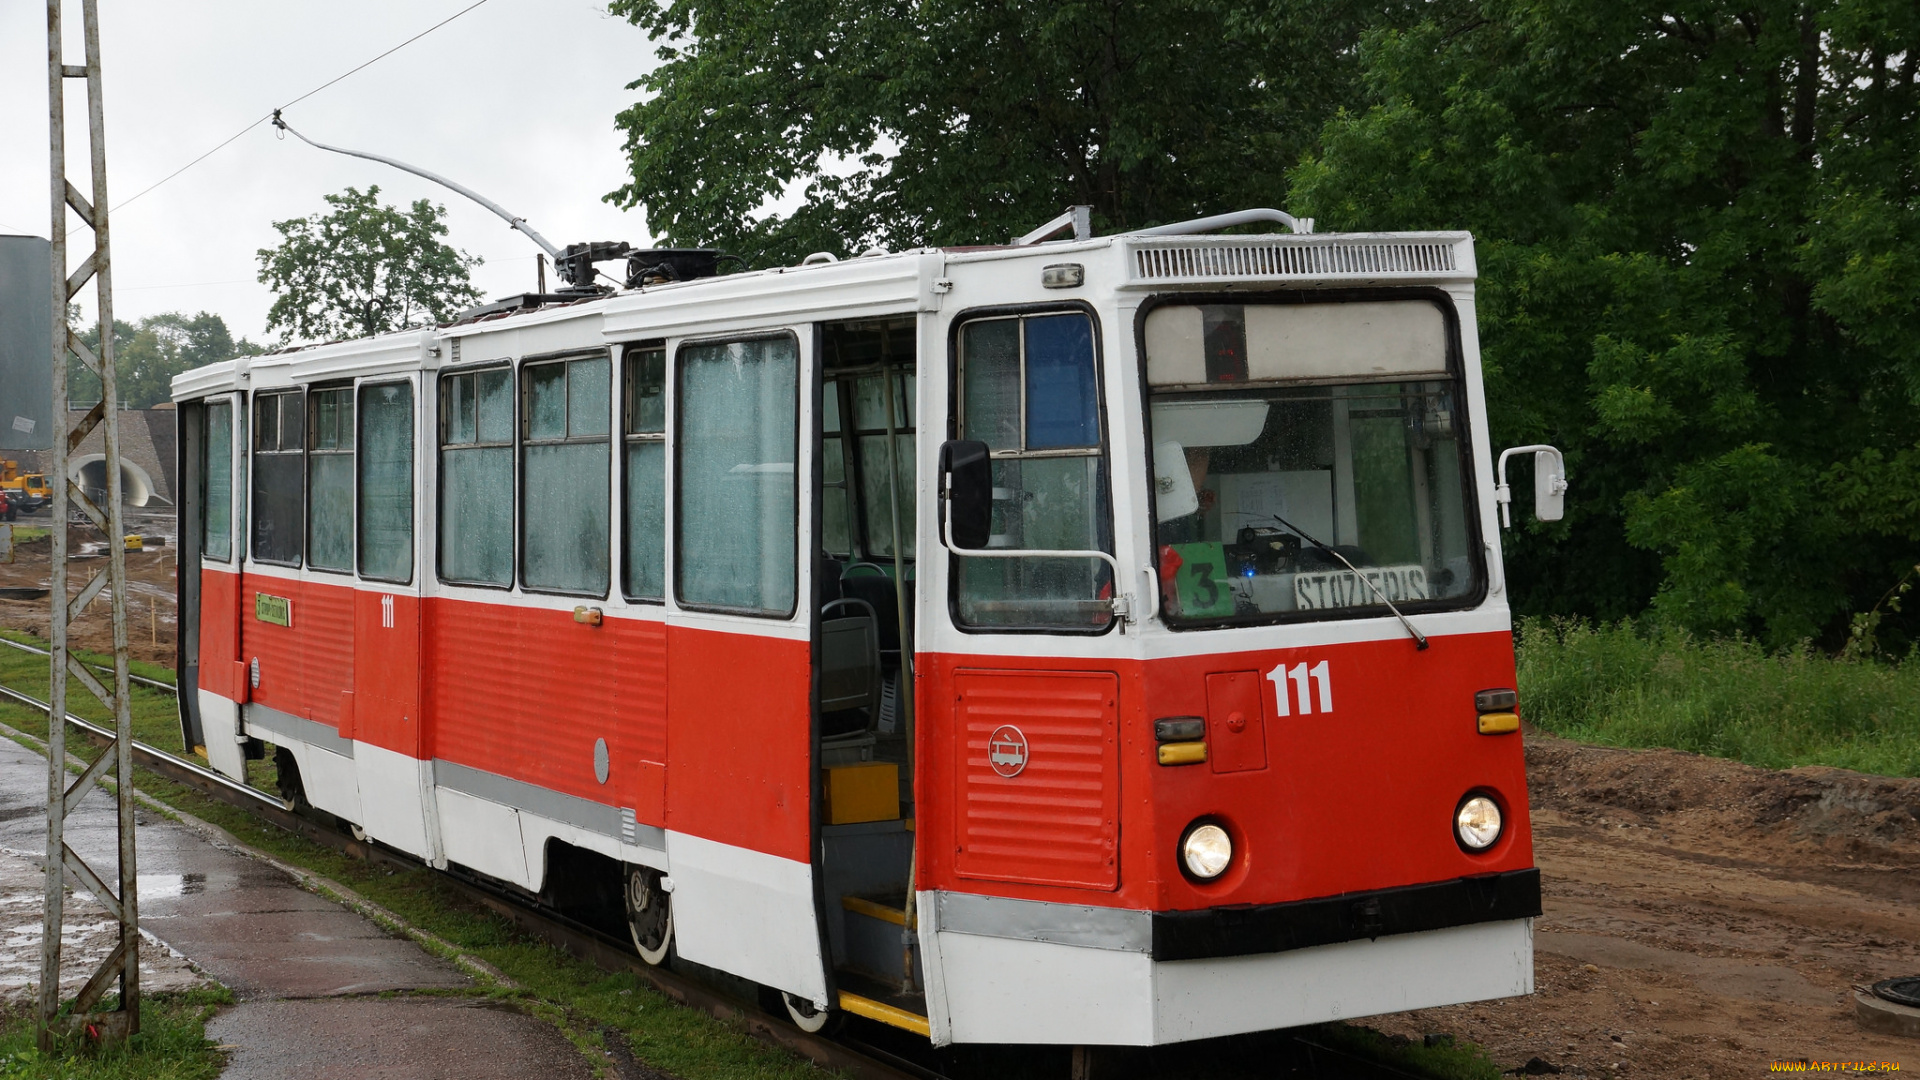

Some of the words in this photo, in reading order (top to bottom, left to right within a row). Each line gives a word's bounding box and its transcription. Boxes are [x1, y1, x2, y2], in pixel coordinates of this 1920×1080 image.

[1190, 562, 1219, 608] 3
[381, 594, 394, 628] 111
[1266, 660, 1333, 717] 111
